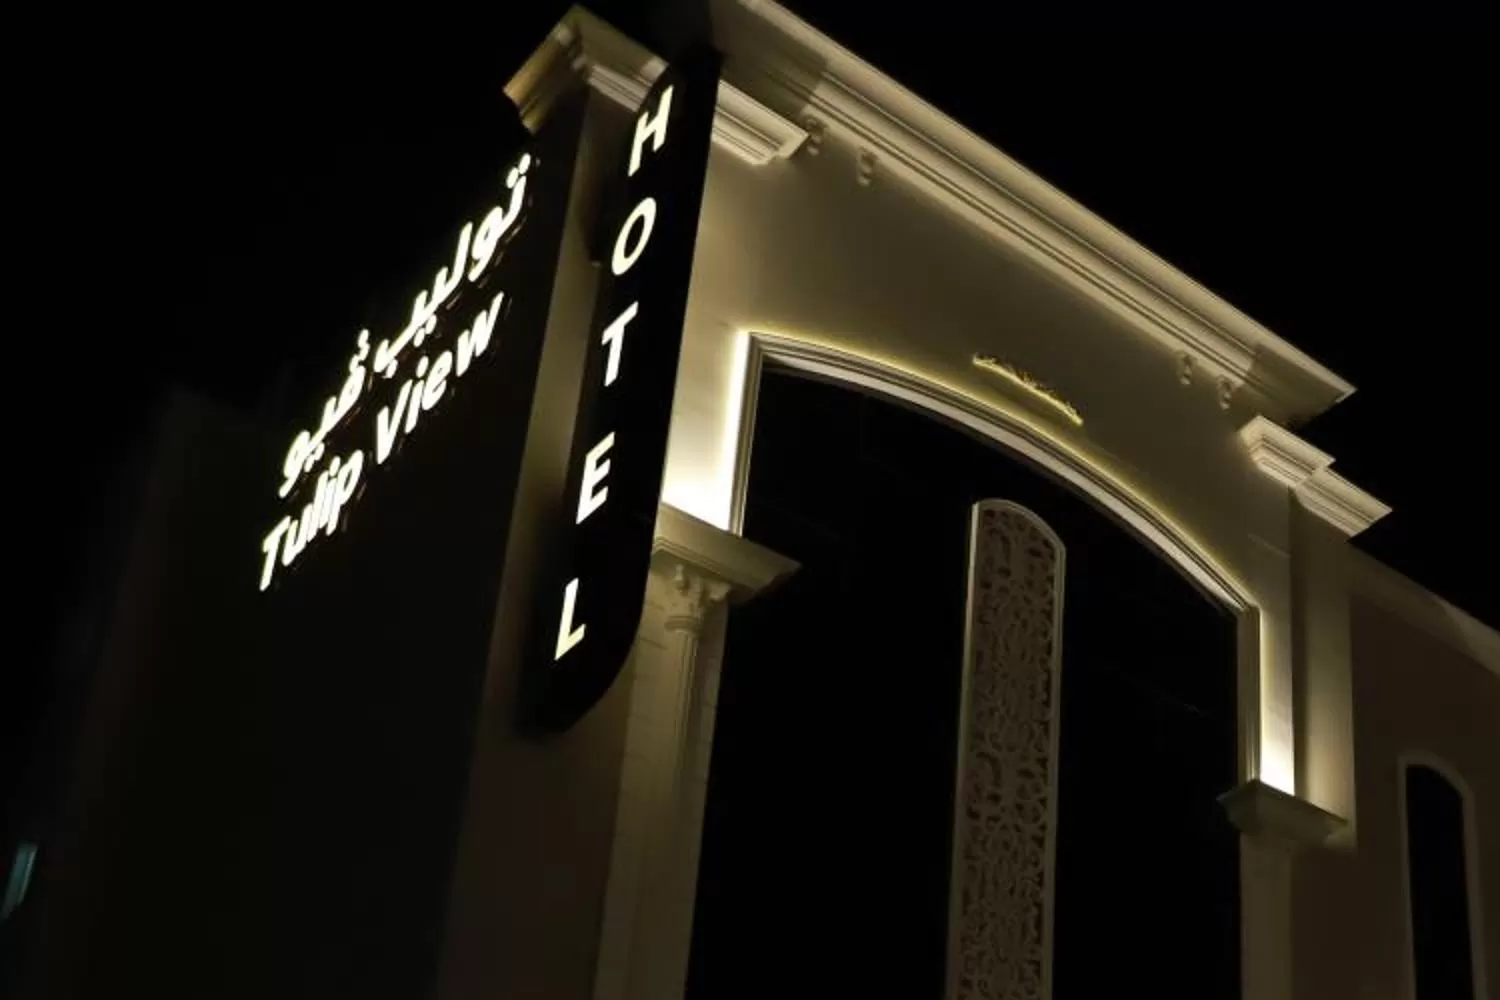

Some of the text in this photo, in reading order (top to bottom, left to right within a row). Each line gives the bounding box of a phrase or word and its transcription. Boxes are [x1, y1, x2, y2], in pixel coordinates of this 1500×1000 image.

[374, 153, 531, 377] توليب
[556, 87, 672, 659] HOTEL
[259, 293, 504, 590] Tulip View
